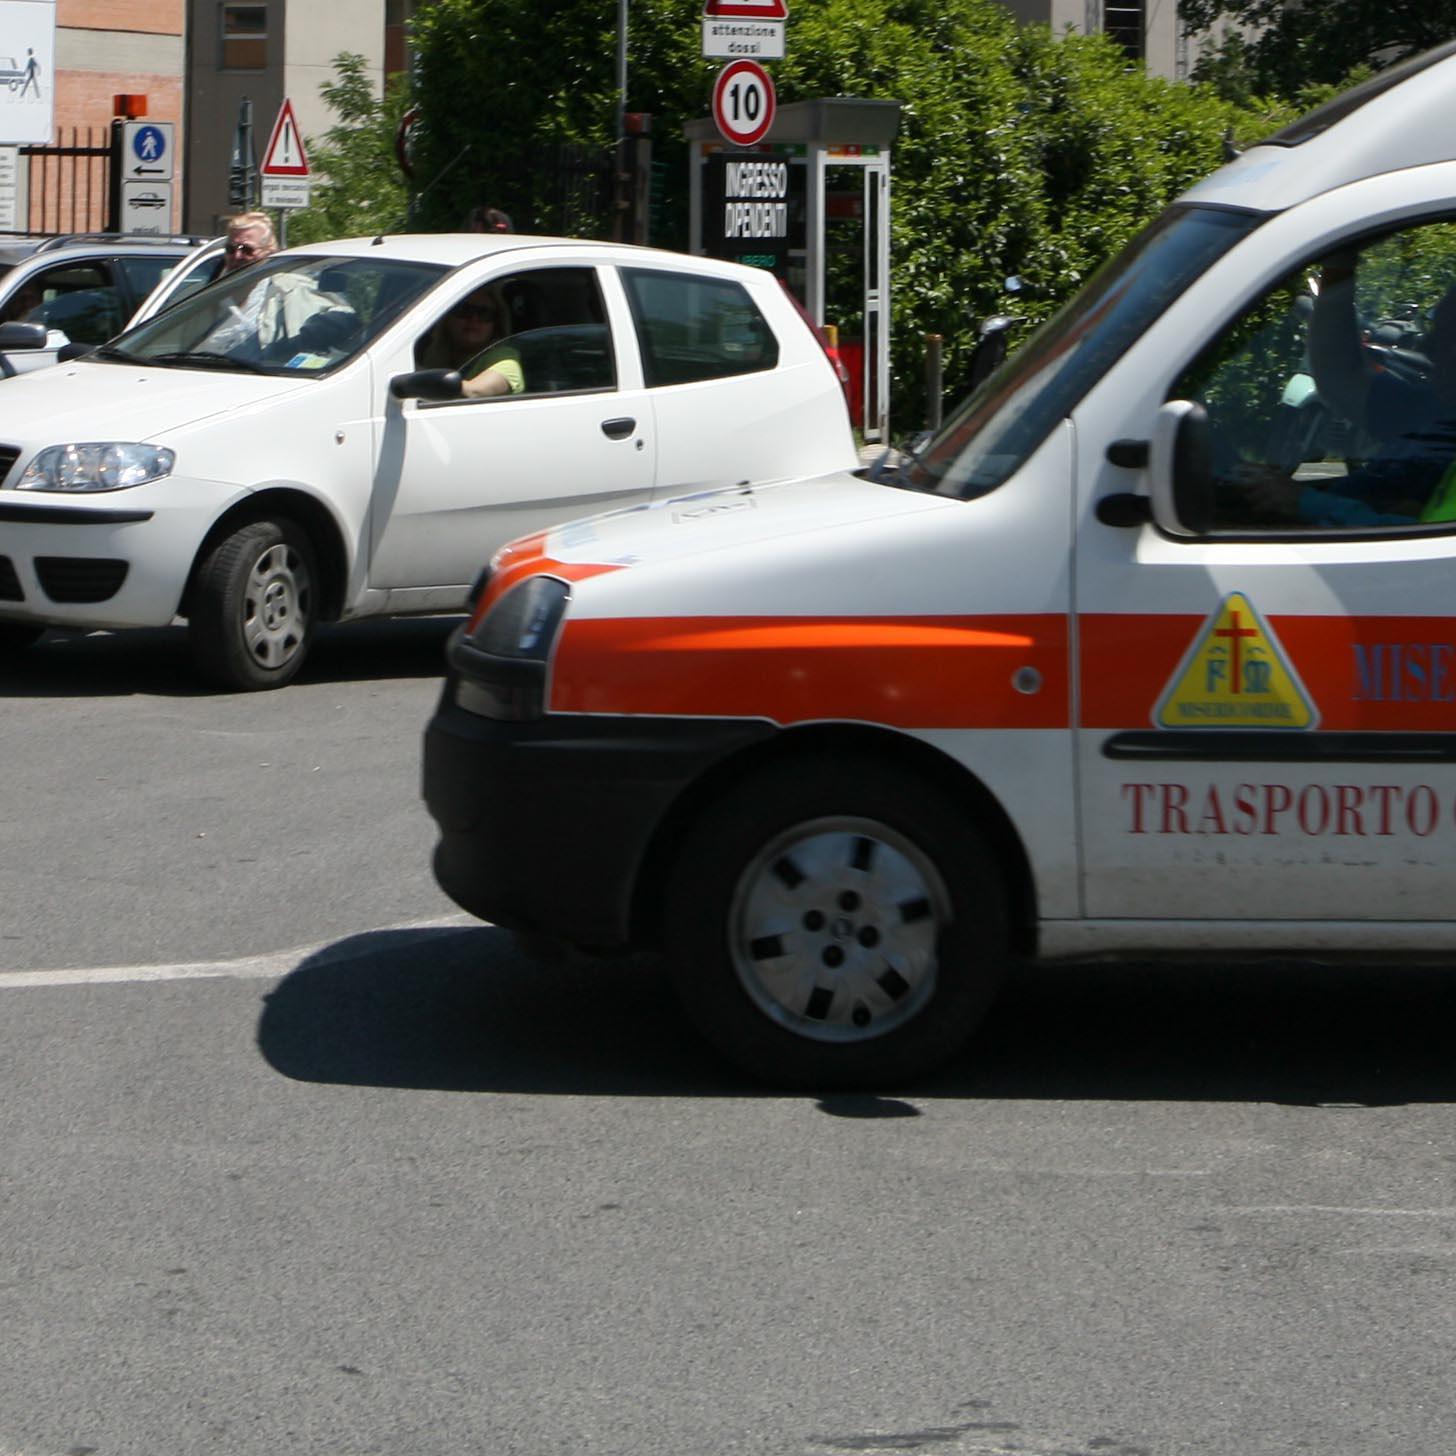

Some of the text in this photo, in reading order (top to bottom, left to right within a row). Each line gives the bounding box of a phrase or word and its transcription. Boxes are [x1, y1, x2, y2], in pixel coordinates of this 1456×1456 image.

[711, 25, 777, 38] attenzione
[727, 41, 761, 54] dossi
[729, 83, 760, 122] 10
[725, 162, 788, 198] INGRESSO
[724, 202, 787, 238] DIPENDENTI
[1121, 783, 1440, 837] TRASPORTO
